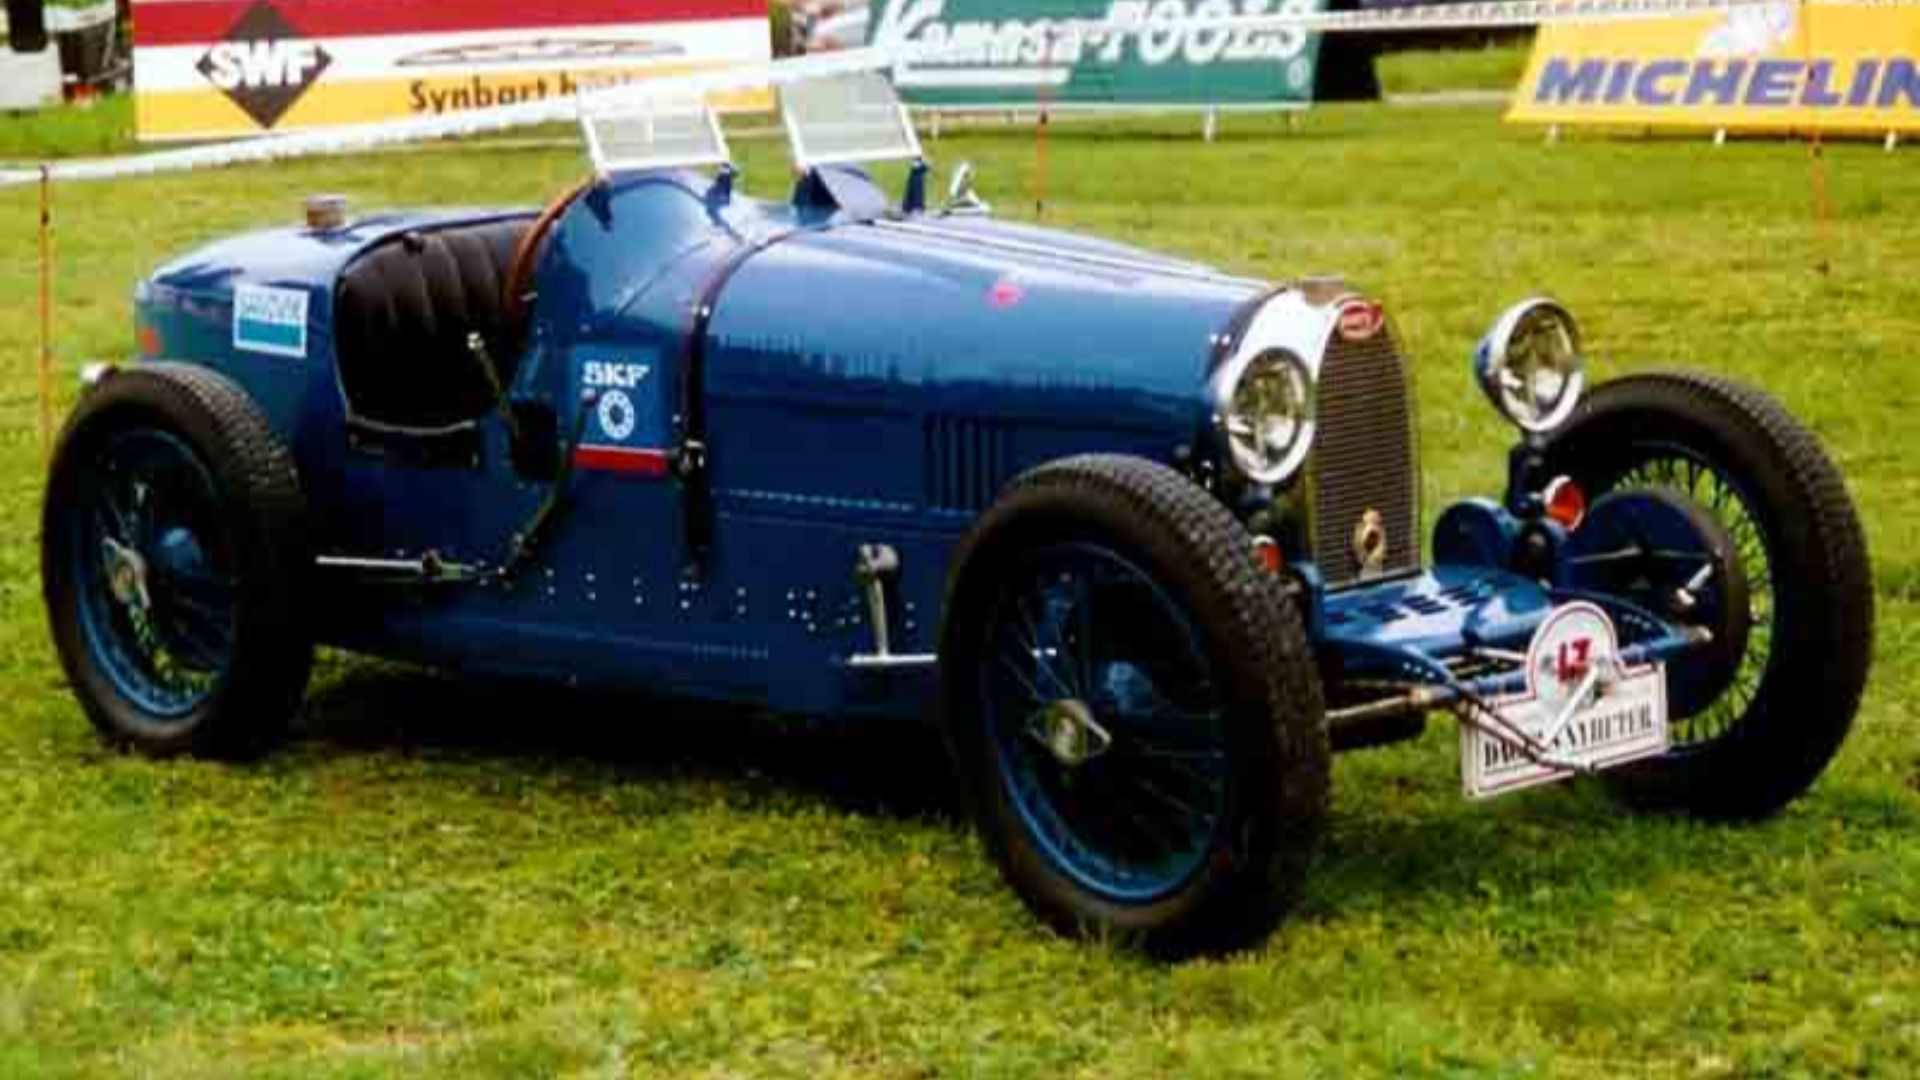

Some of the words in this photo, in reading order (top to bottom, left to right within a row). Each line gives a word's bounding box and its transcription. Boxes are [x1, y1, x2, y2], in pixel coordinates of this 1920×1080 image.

[209, 40, 318, 88] SWF
[1535, 56, 1920, 107] MICHELIN
[582, 359, 650, 389] SKF
